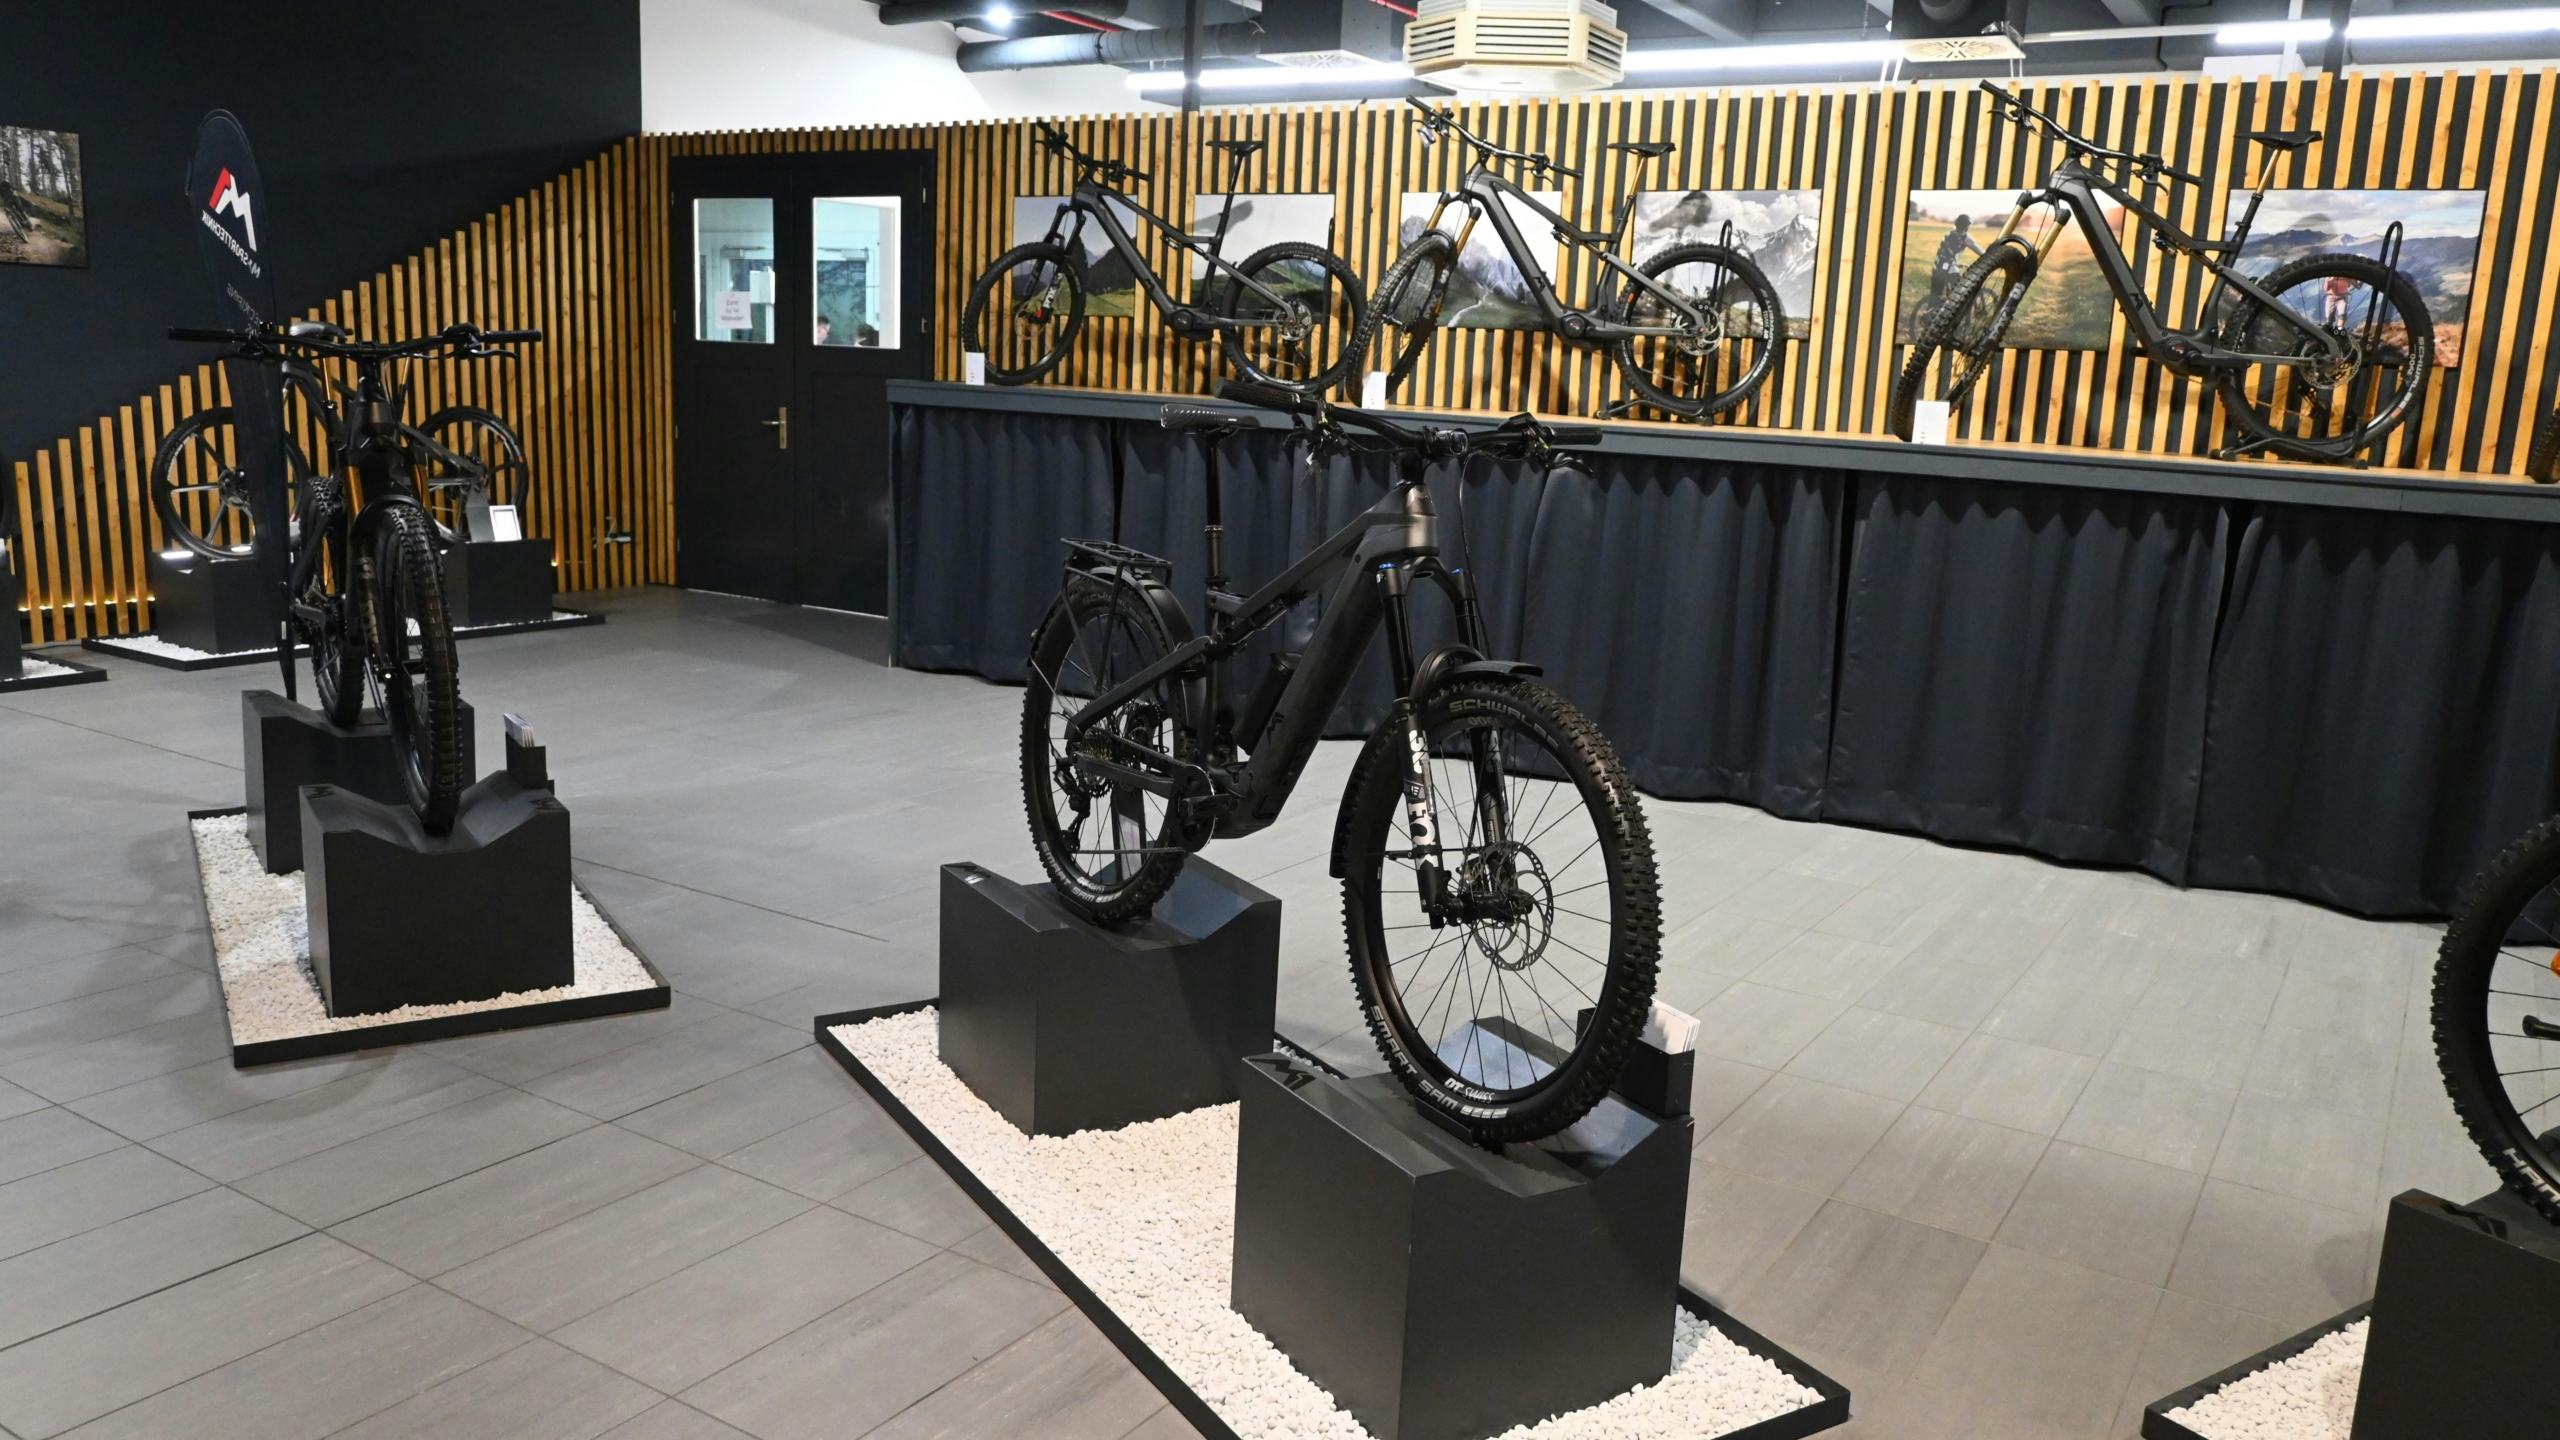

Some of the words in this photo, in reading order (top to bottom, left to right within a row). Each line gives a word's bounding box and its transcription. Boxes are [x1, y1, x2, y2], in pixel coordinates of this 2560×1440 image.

[2399, 336, 2425, 410] SCHWALBE
[1450, 700, 1559, 750] SCHWALBE
[1370, 1005, 1419, 1075] SMART
[1418, 1079, 1459, 1110] SAM
[1444, 1077, 1464, 1093] DT
[1463, 1086, 1495, 1104] SWISS
